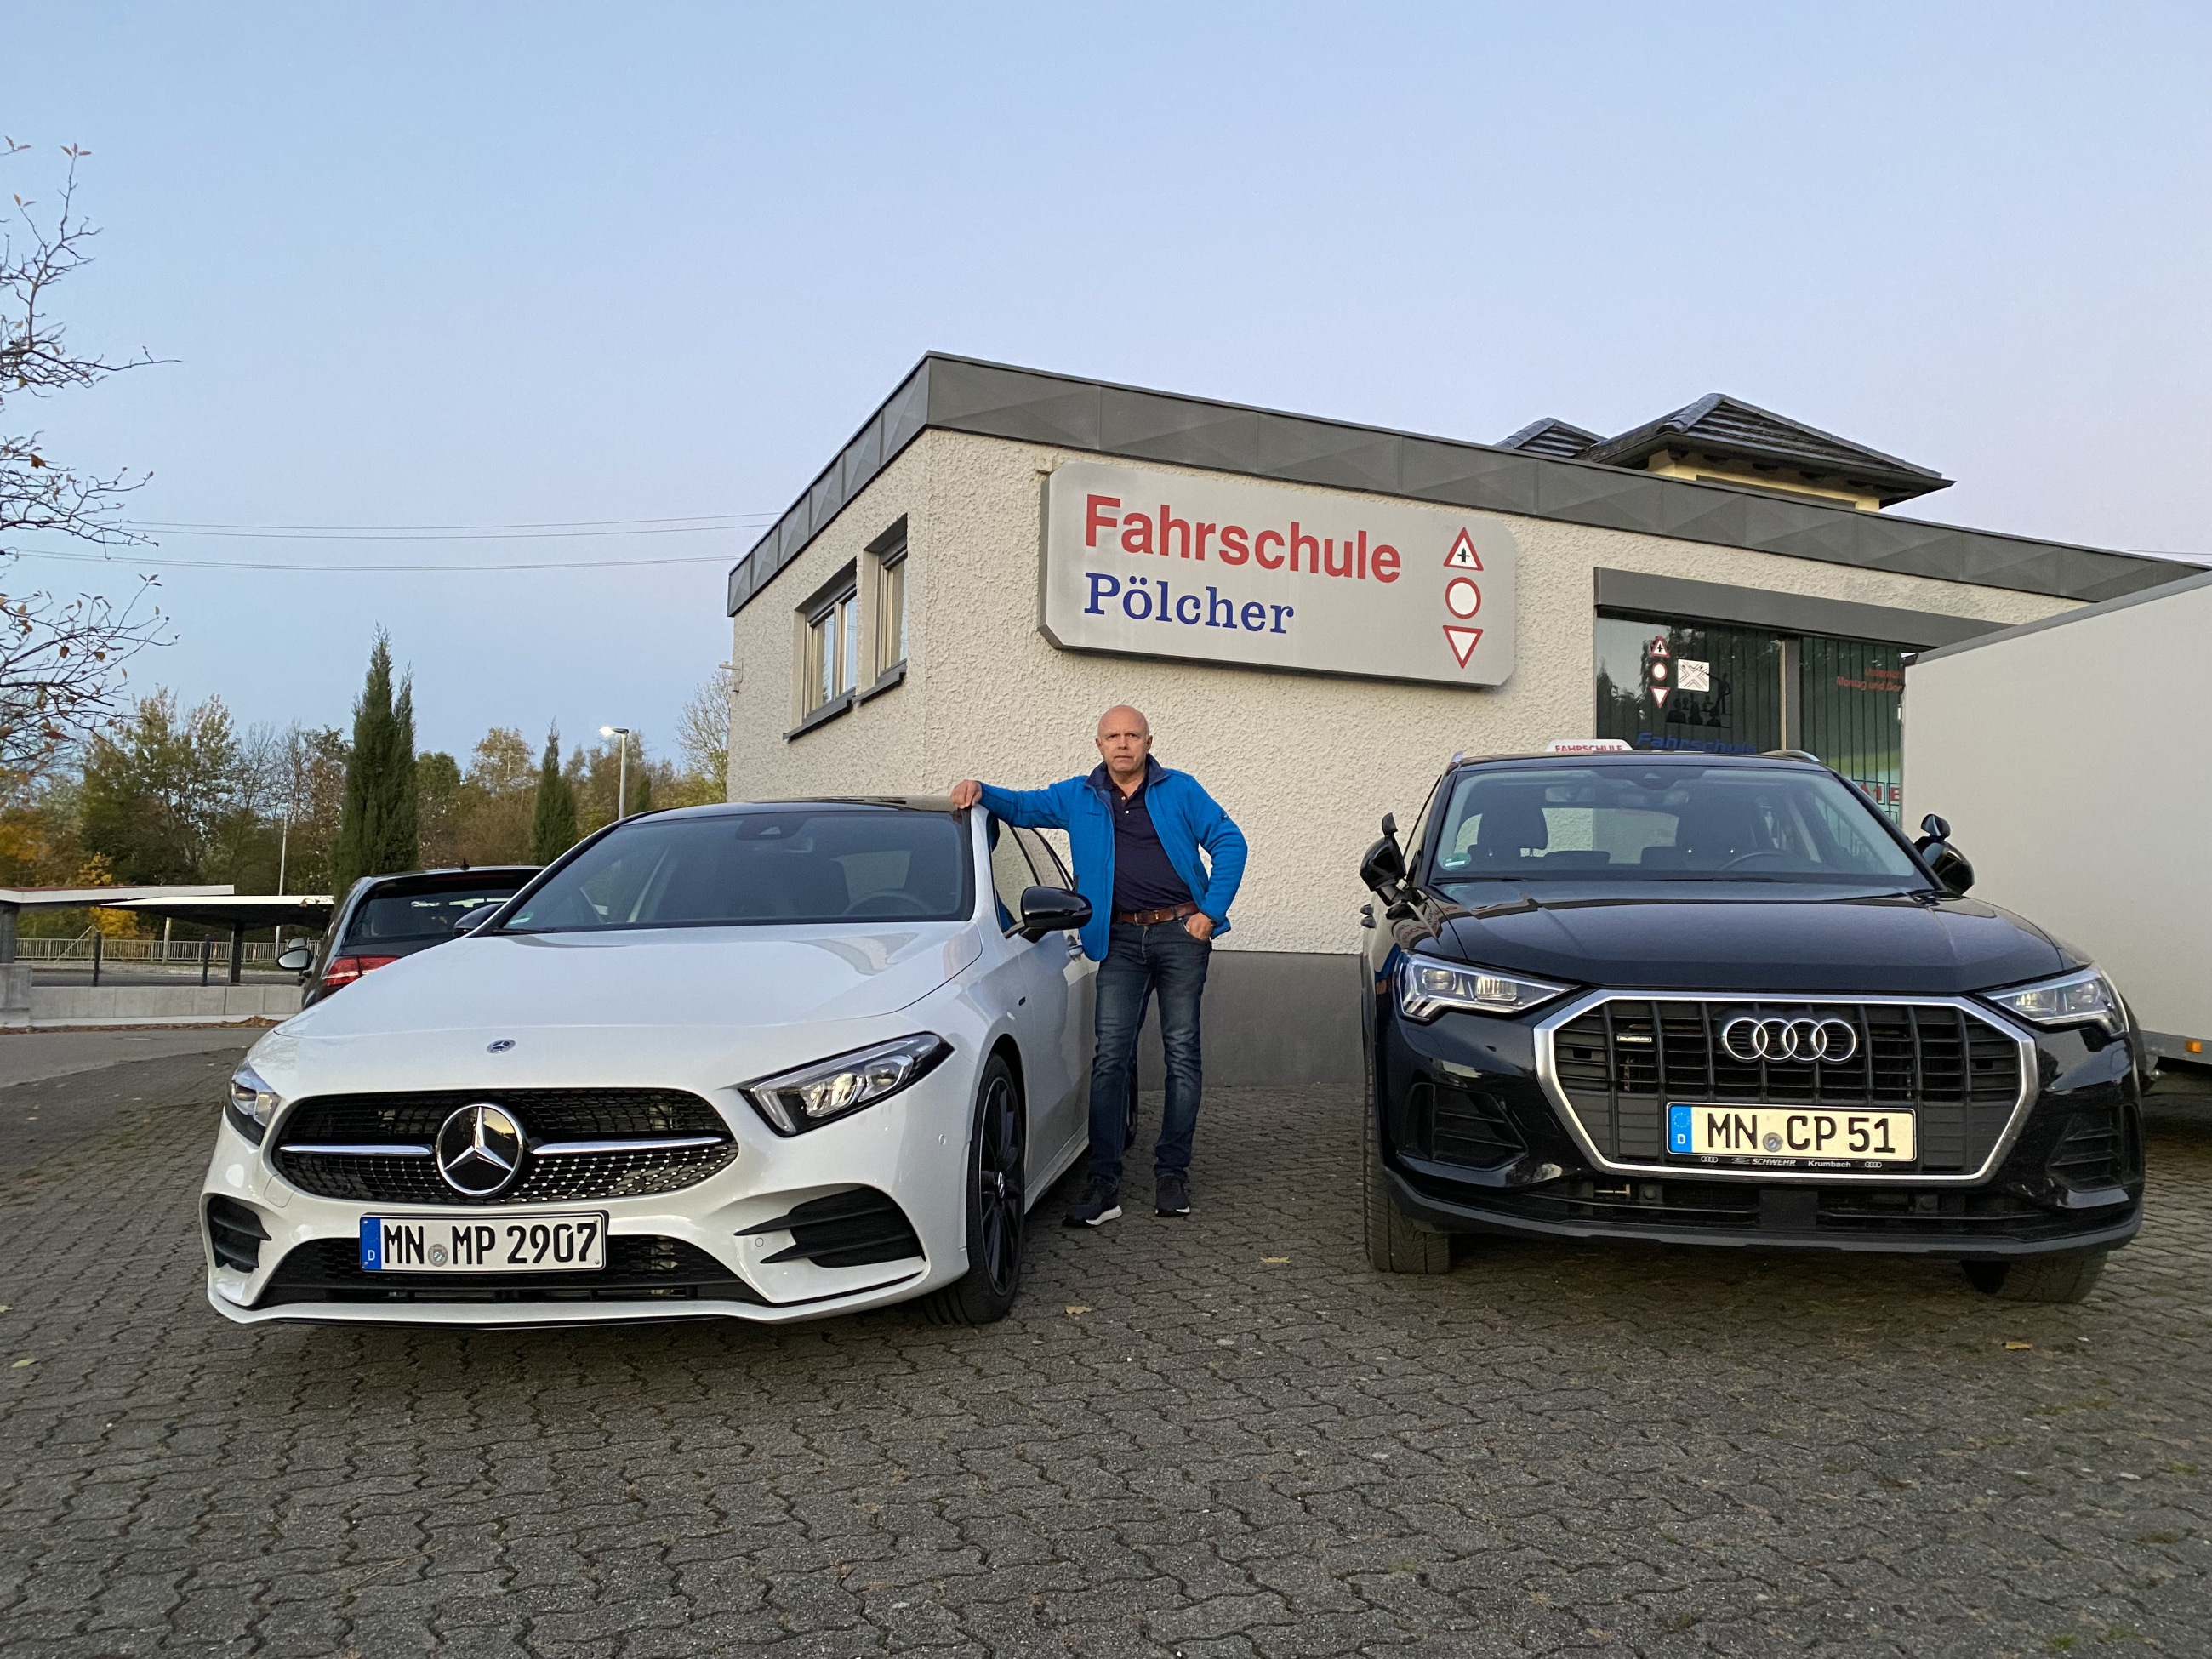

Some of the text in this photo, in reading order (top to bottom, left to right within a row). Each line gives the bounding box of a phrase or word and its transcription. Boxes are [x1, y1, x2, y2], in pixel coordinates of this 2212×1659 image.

[1086, 493, 1401, 584] Fahrschule
[1084, 572, 1295, 635] Pölcher
[1677, 1112, 1896, 1154] D MN CP 51
[1752, 1157, 1851, 1168] SCHWEHR Krumbach
[367, 1223, 598, 1265] D MN MP 2907
